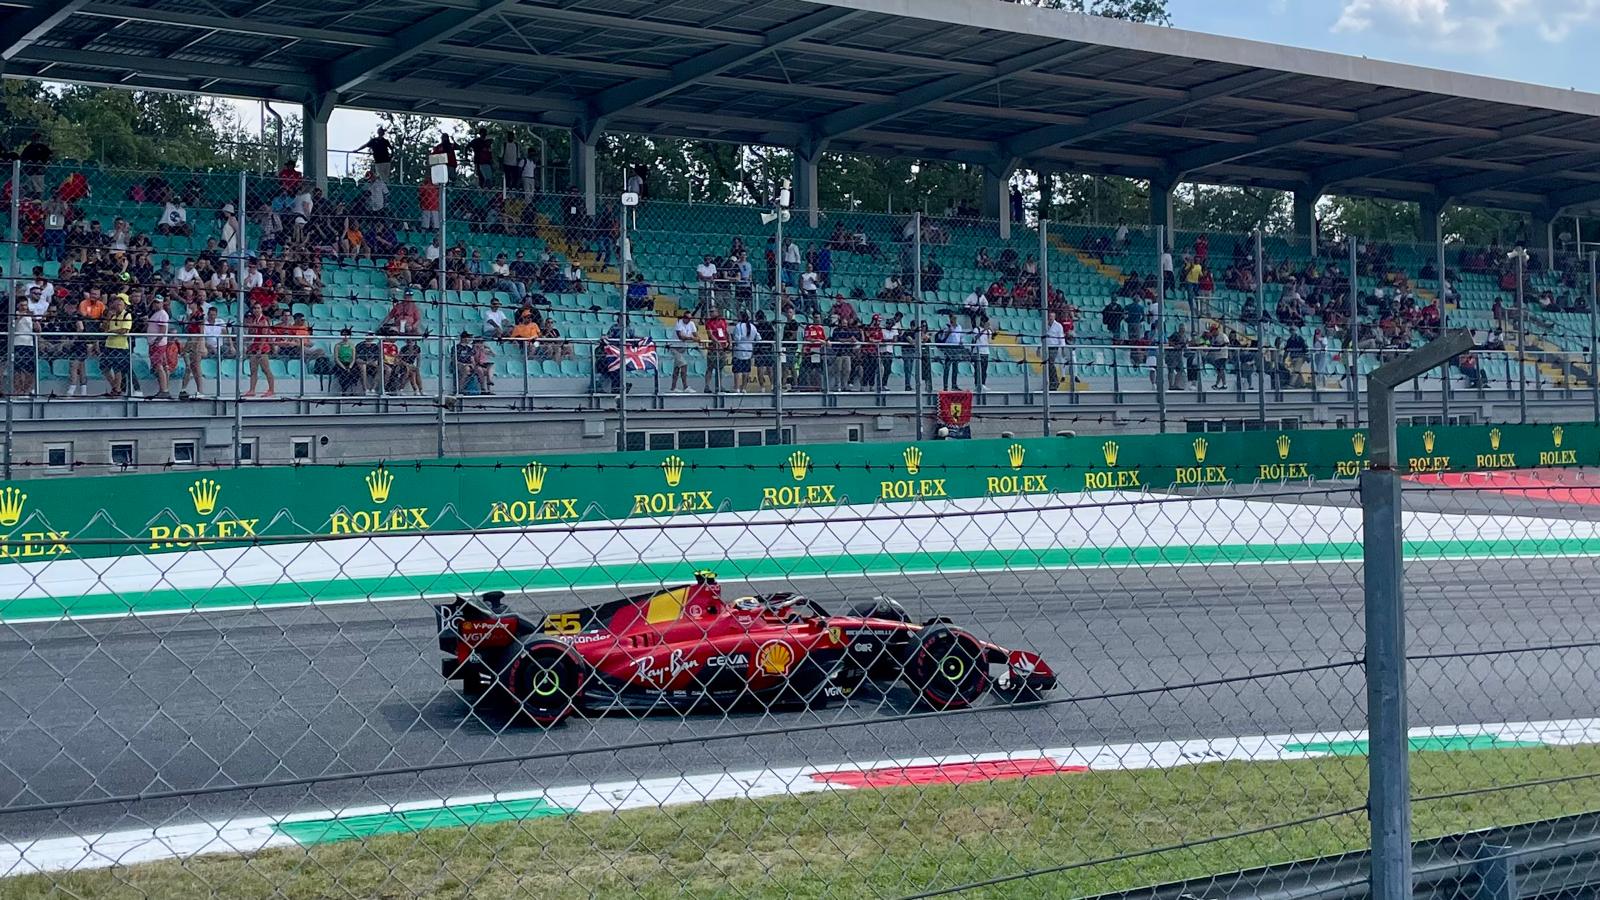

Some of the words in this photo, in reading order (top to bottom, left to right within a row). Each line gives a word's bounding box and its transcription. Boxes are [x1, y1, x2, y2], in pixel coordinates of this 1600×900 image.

[1408, 456, 1452, 472] ROLEX
[1476, 453, 1516, 468] ROLEX
[1539, 450, 1576, 466] ROLEX
[1175, 466, 1227, 483] ROLEX
[1259, 463, 1309, 480] ROLEX
[1337, 460, 1371, 476] ROLE
[987, 475, 1048, 493] ROLEX
[1085, 470, 1141, 488] ROLEX
[763, 484, 836, 507] ROLEX
[880, 479, 947, 499] ROLEX
[491, 499, 578, 523] ROLEX
[634, 491, 713, 514] ROLEX
[330, 508, 430, 535] ROLEX
[149, 519, 260, 549] ROLEX
[543, 613, 582, 636] 55
[707, 654, 749, 667] CEVA
